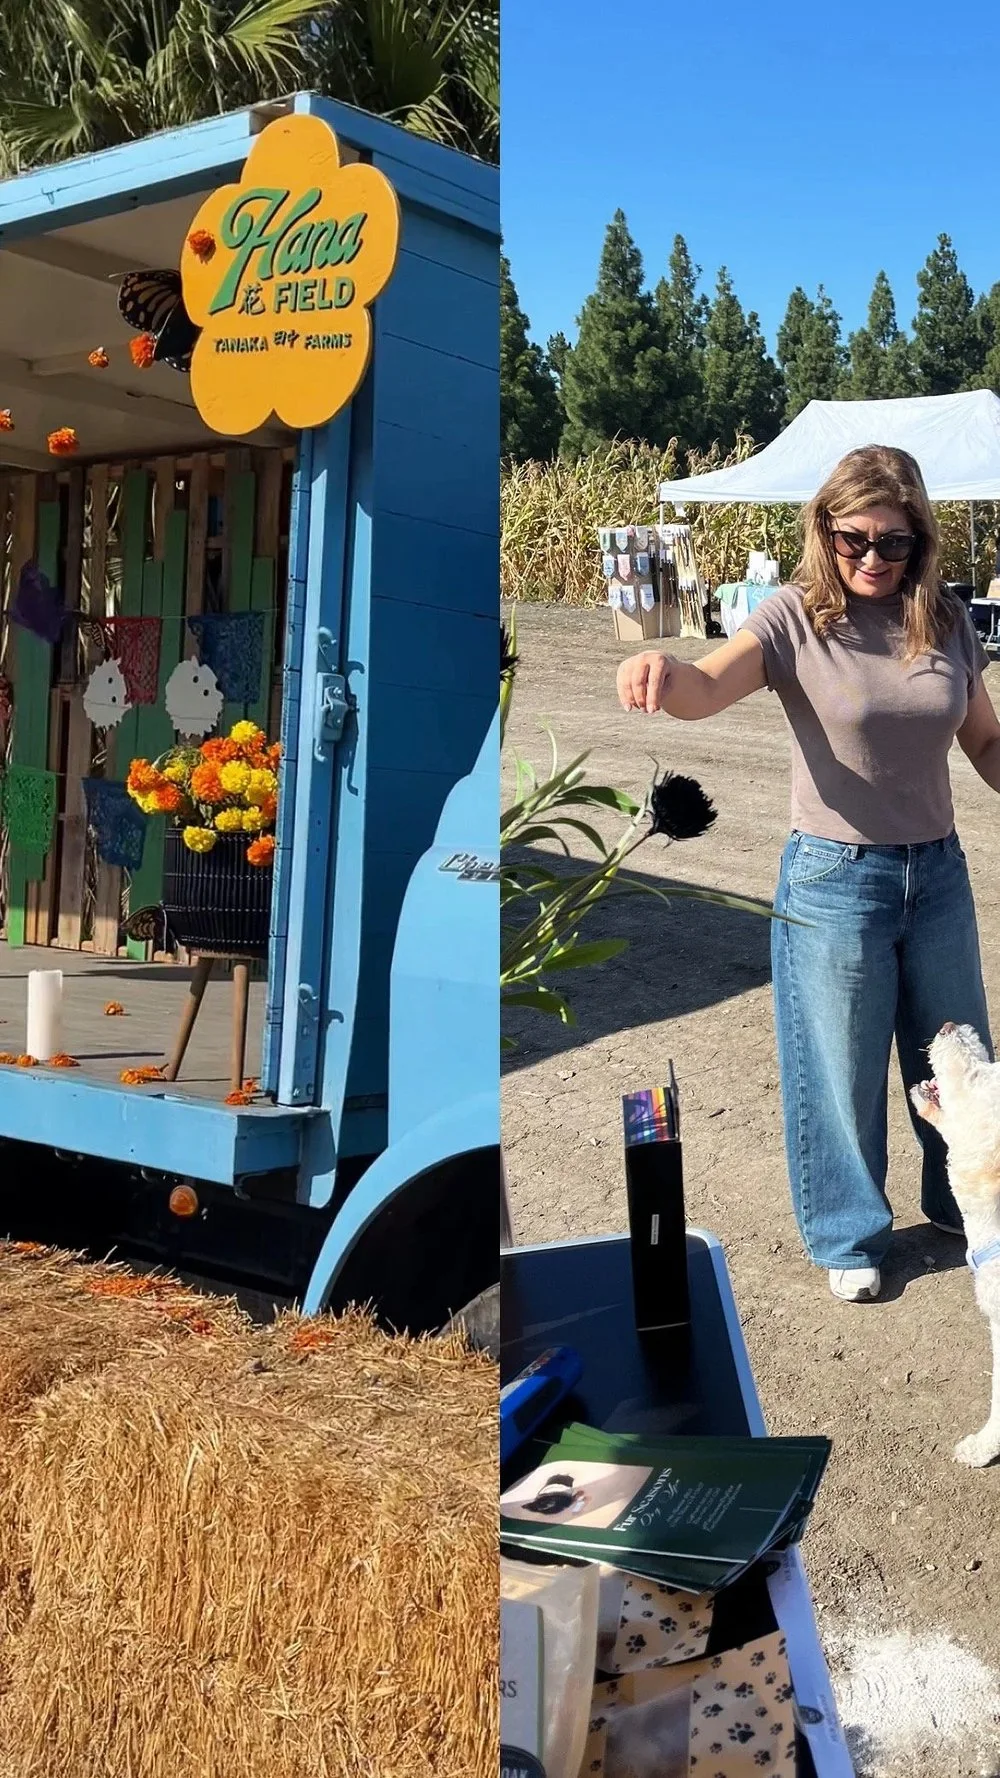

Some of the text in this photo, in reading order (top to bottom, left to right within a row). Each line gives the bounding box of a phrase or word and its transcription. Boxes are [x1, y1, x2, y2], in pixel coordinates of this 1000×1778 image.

[209, 187, 368, 315] Hana
[239, 275, 356, 315] 花 FIELD
[213, 335, 269, 354] TANAKA
[303, 332, 353, 350] FARMS
[613, 1514, 637, 1532] Fur
